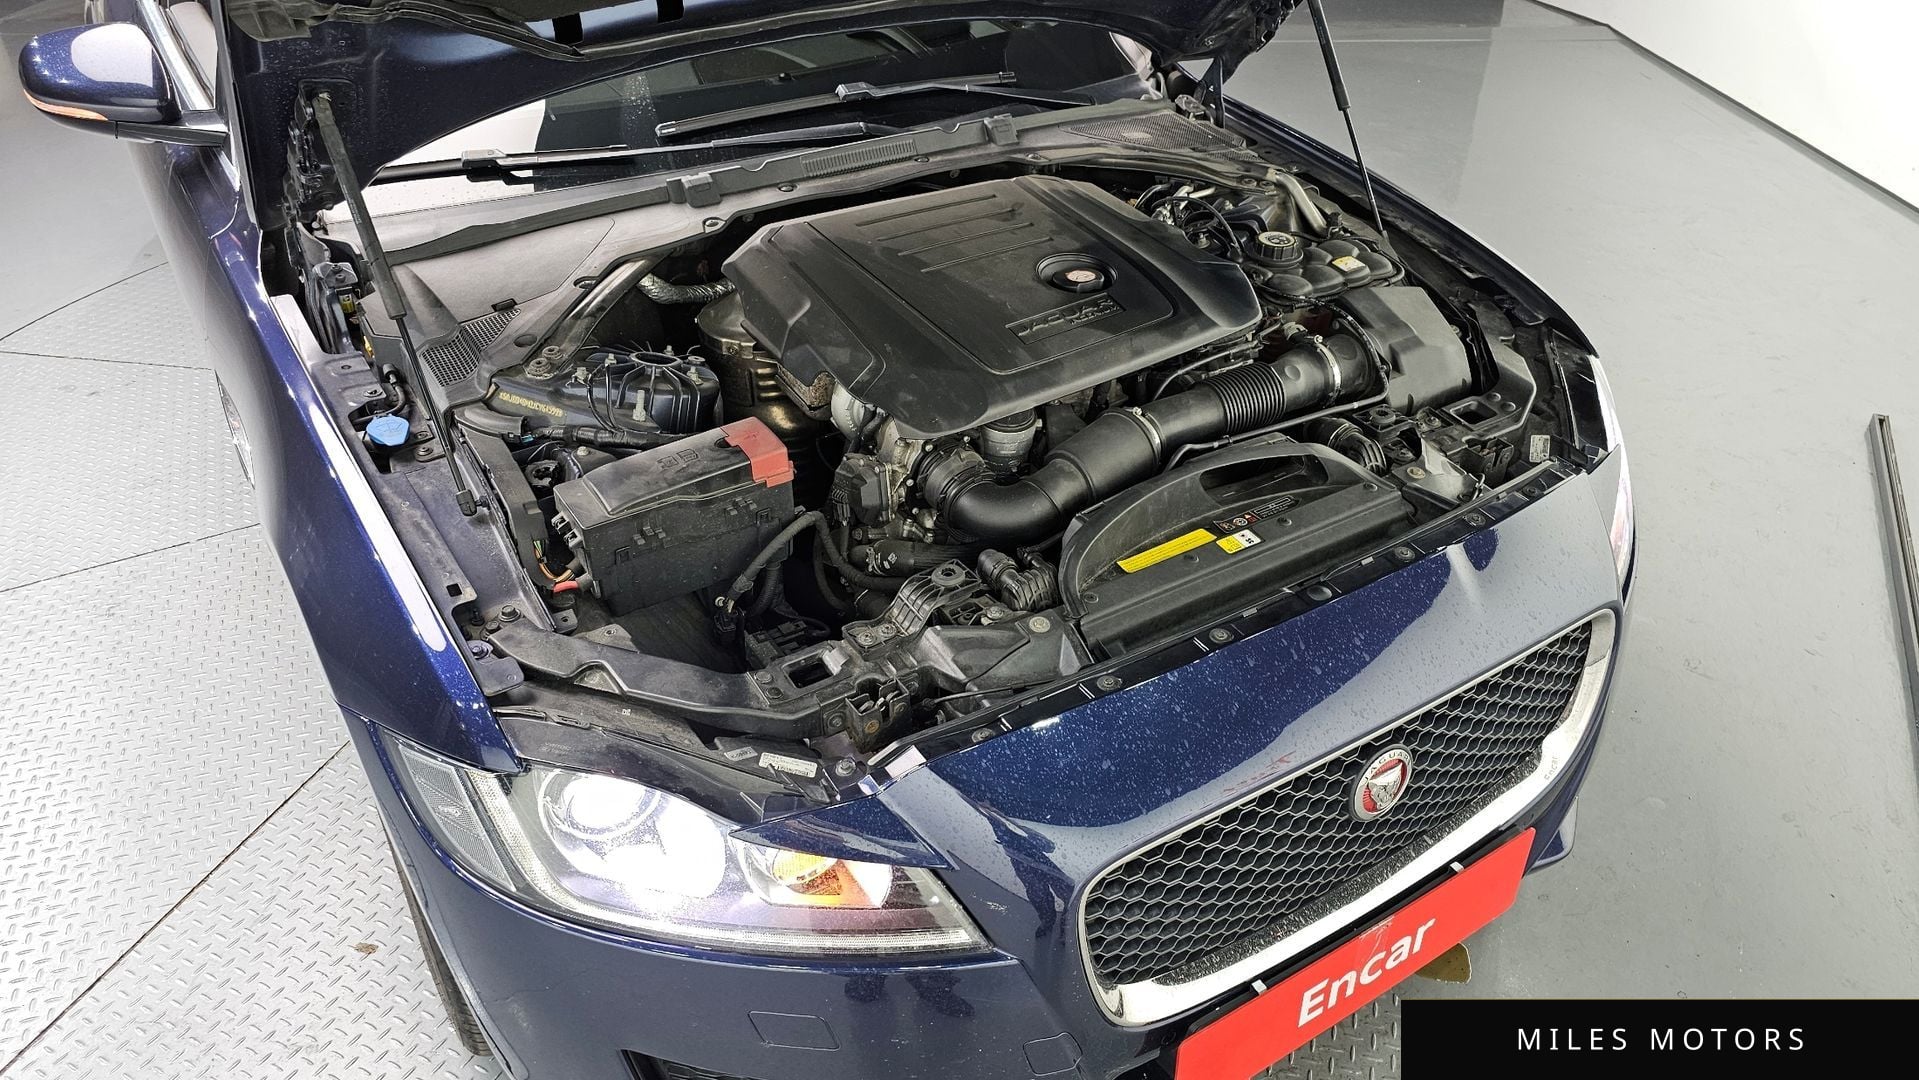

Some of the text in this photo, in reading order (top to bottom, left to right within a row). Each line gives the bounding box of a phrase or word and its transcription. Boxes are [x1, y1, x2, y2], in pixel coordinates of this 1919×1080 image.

[1017, 299, 1114, 337] JAGUAR
[1364, 751, 1411, 782] JAGUAR
[1298, 918, 1437, 1028] Encar
